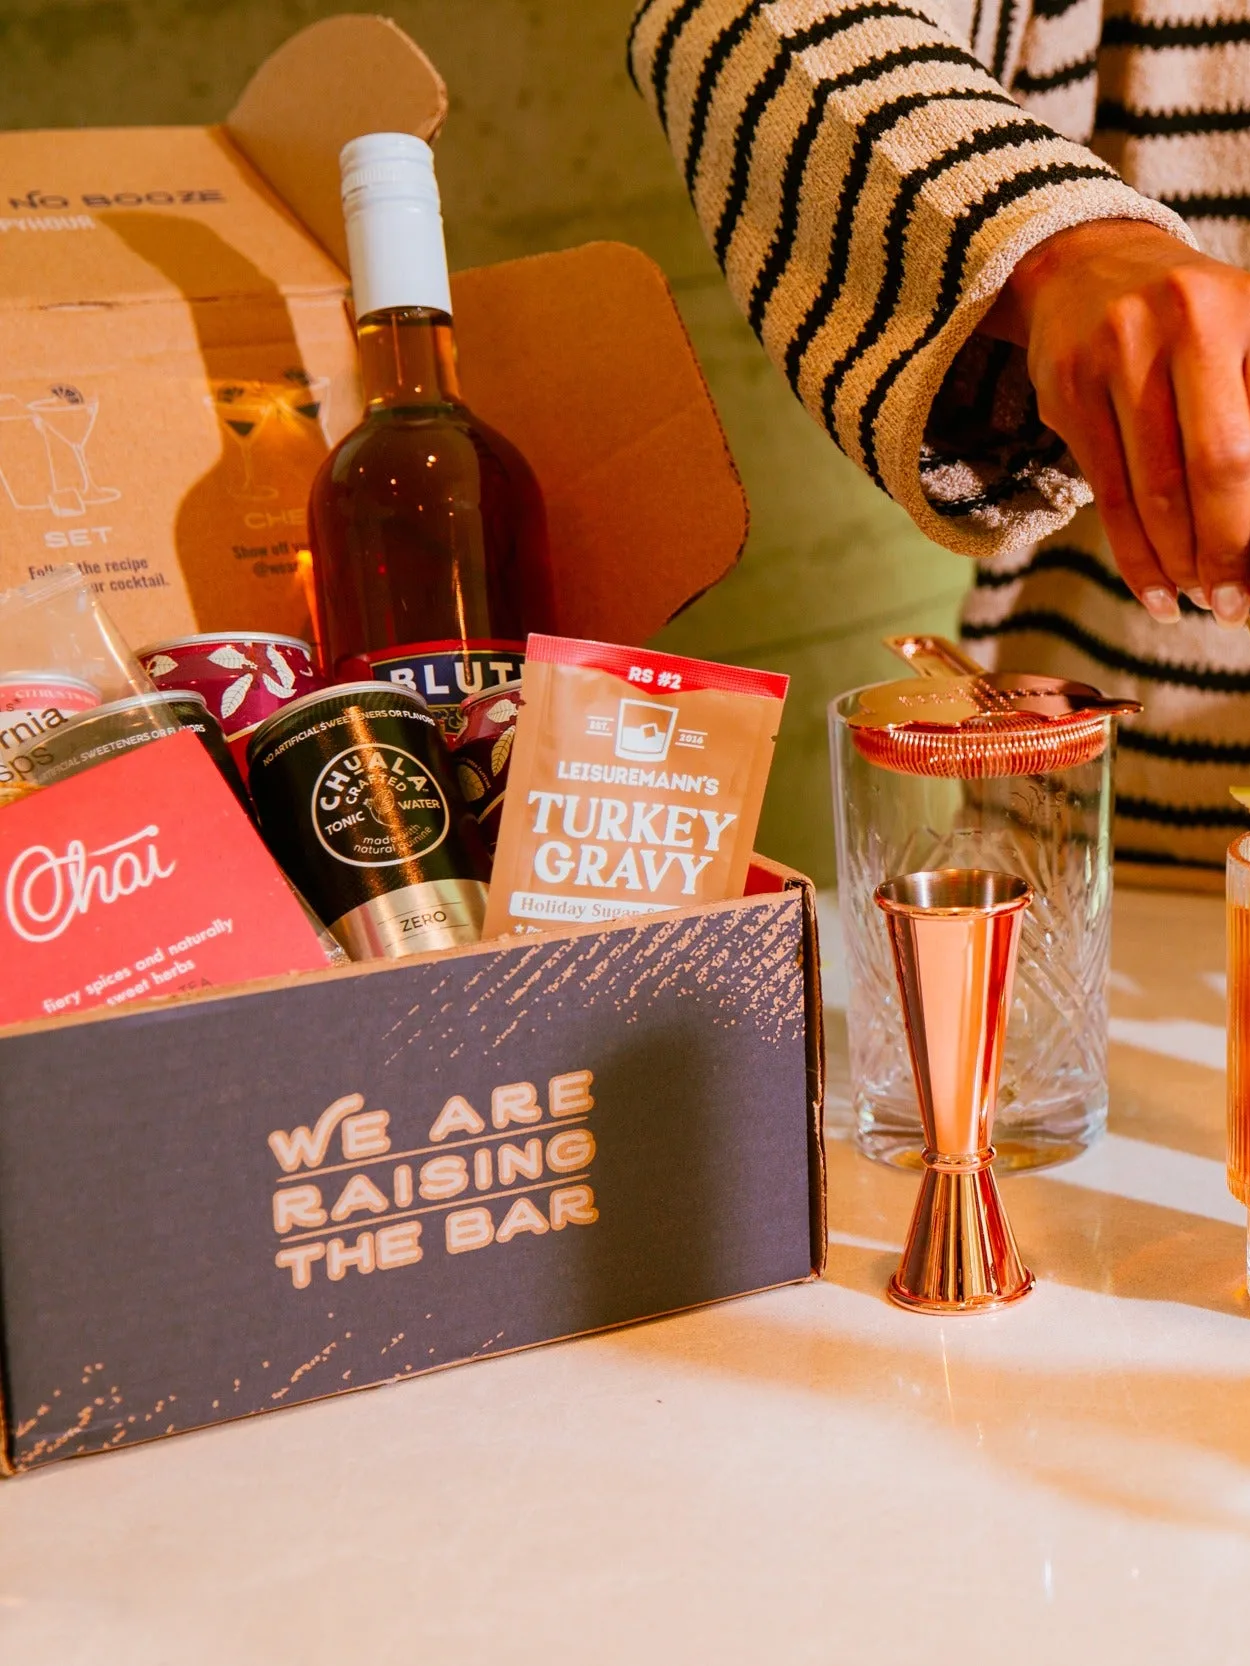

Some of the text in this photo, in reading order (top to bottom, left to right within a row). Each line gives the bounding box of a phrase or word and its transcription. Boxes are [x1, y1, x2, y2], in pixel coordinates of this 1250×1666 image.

[9, 189, 225, 210] NO BOOZE
[244, 508, 308, 529] CHE
[44, 527, 112, 548] SET
[77, 560, 102, 576] the
[105, 557, 149, 573] recipe
[110, 572, 170, 592] cocktail.
[390, 661, 526, 695] BLUT
[628, 666, 682, 690] RS #2
[80, 732, 150, 762] SWEETENERS
[151, 728, 167, 739] OR
[262, 709, 436, 767] NO ARTIFICIAL SWEETENERS OR FLAVORS
[679, 732, 704, 745] 2016
[320, 752, 427, 811] CHUALA
[345, 774, 407, 804] CRAFTED
[557, 760, 720, 796] LEISUREMANN'S
[325, 799, 440, 836] TONIC WATER
[363, 823, 421, 845] made with
[527, 790, 737, 852] TURKEY
[353, 844, 396, 855] natural
[533, 840, 713, 895] GRAVY
[400, 911, 447, 932] ZERO
[520, 897, 586, 919] Holiday
[42, 918, 233, 1014] fiery spices and naturally
[106, 959, 196, 1007] sweet herbs
[267, 1069, 595, 1173] WE ARE
[272, 1128, 597, 1234] RAISING
[275, 1184, 600, 1290] THE BAR
